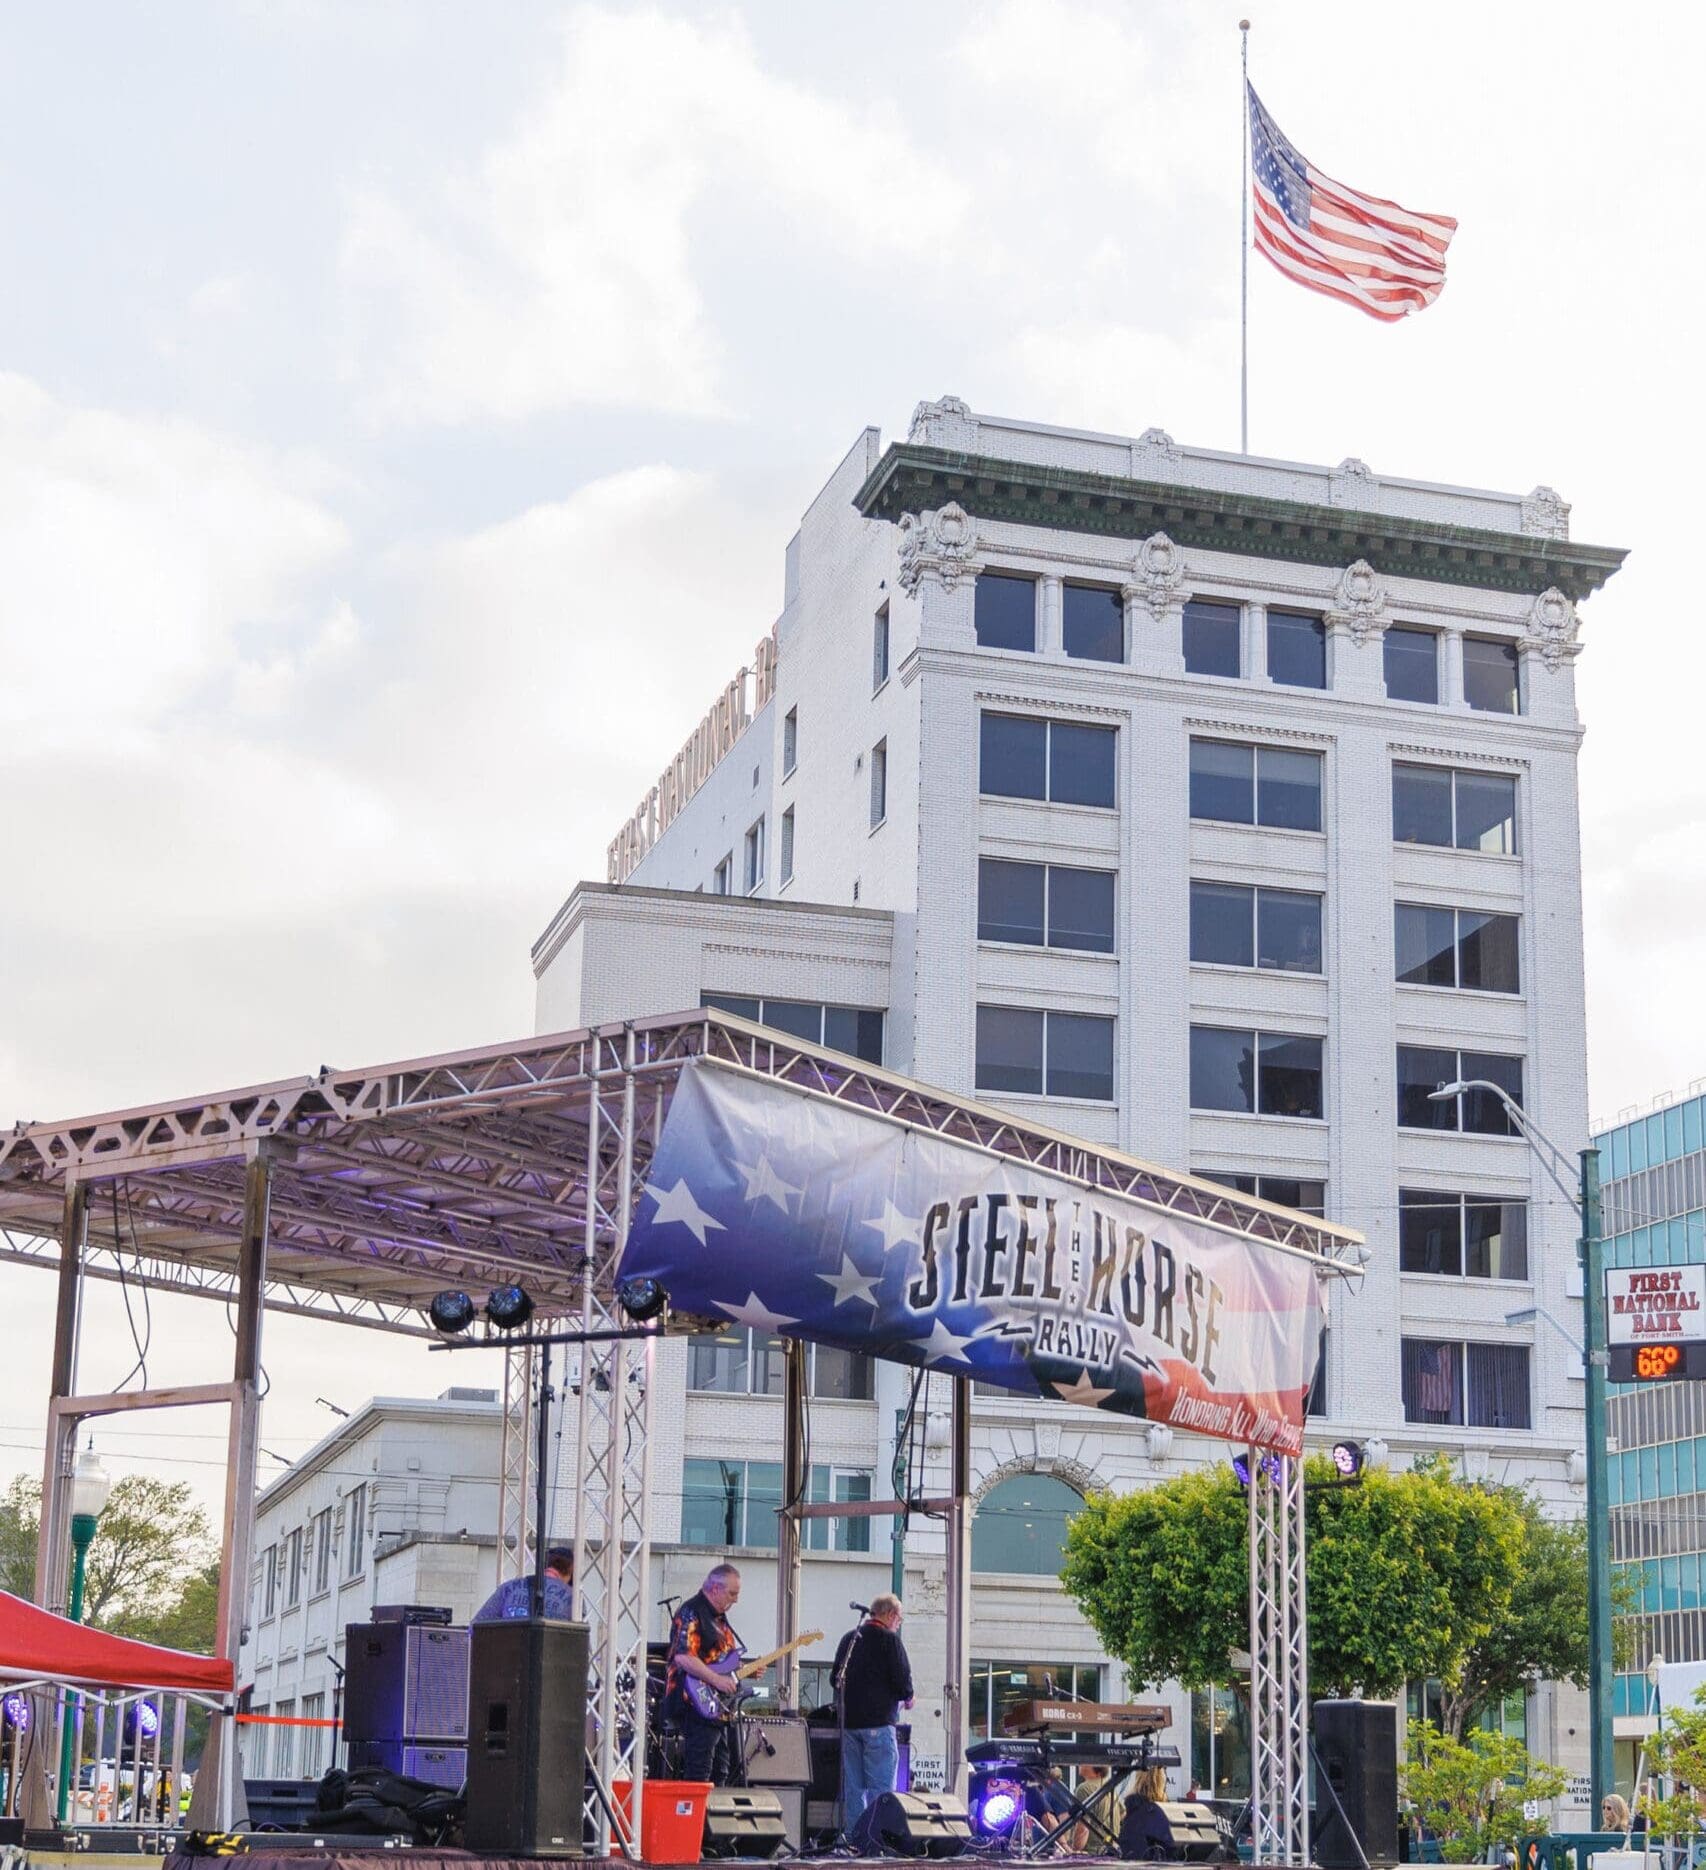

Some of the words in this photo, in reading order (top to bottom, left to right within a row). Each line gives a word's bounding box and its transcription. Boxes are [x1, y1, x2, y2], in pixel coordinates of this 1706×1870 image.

[909, 1194, 1061, 1309] STEEL
[1072, 1202, 1081, 1282] THE
[1629, 1272, 1682, 1293] FIRST
[1087, 1211, 1223, 1386] HORSE
[1613, 1292, 1700, 1314] NATIONAL
[1632, 1313, 1682, 1333] BANK
[1039, 1319, 1118, 1365] RALLY
[1169, 1385, 1232, 1431] HONORING
[1228, 1402, 1251, 1438] ALL
[1250, 1407, 1279, 1444] WHO
[504, 1579, 571, 1602] AMECA
[513, 1594, 560, 1612] FIGER
[1042, 1708, 1066, 1719] KORG
